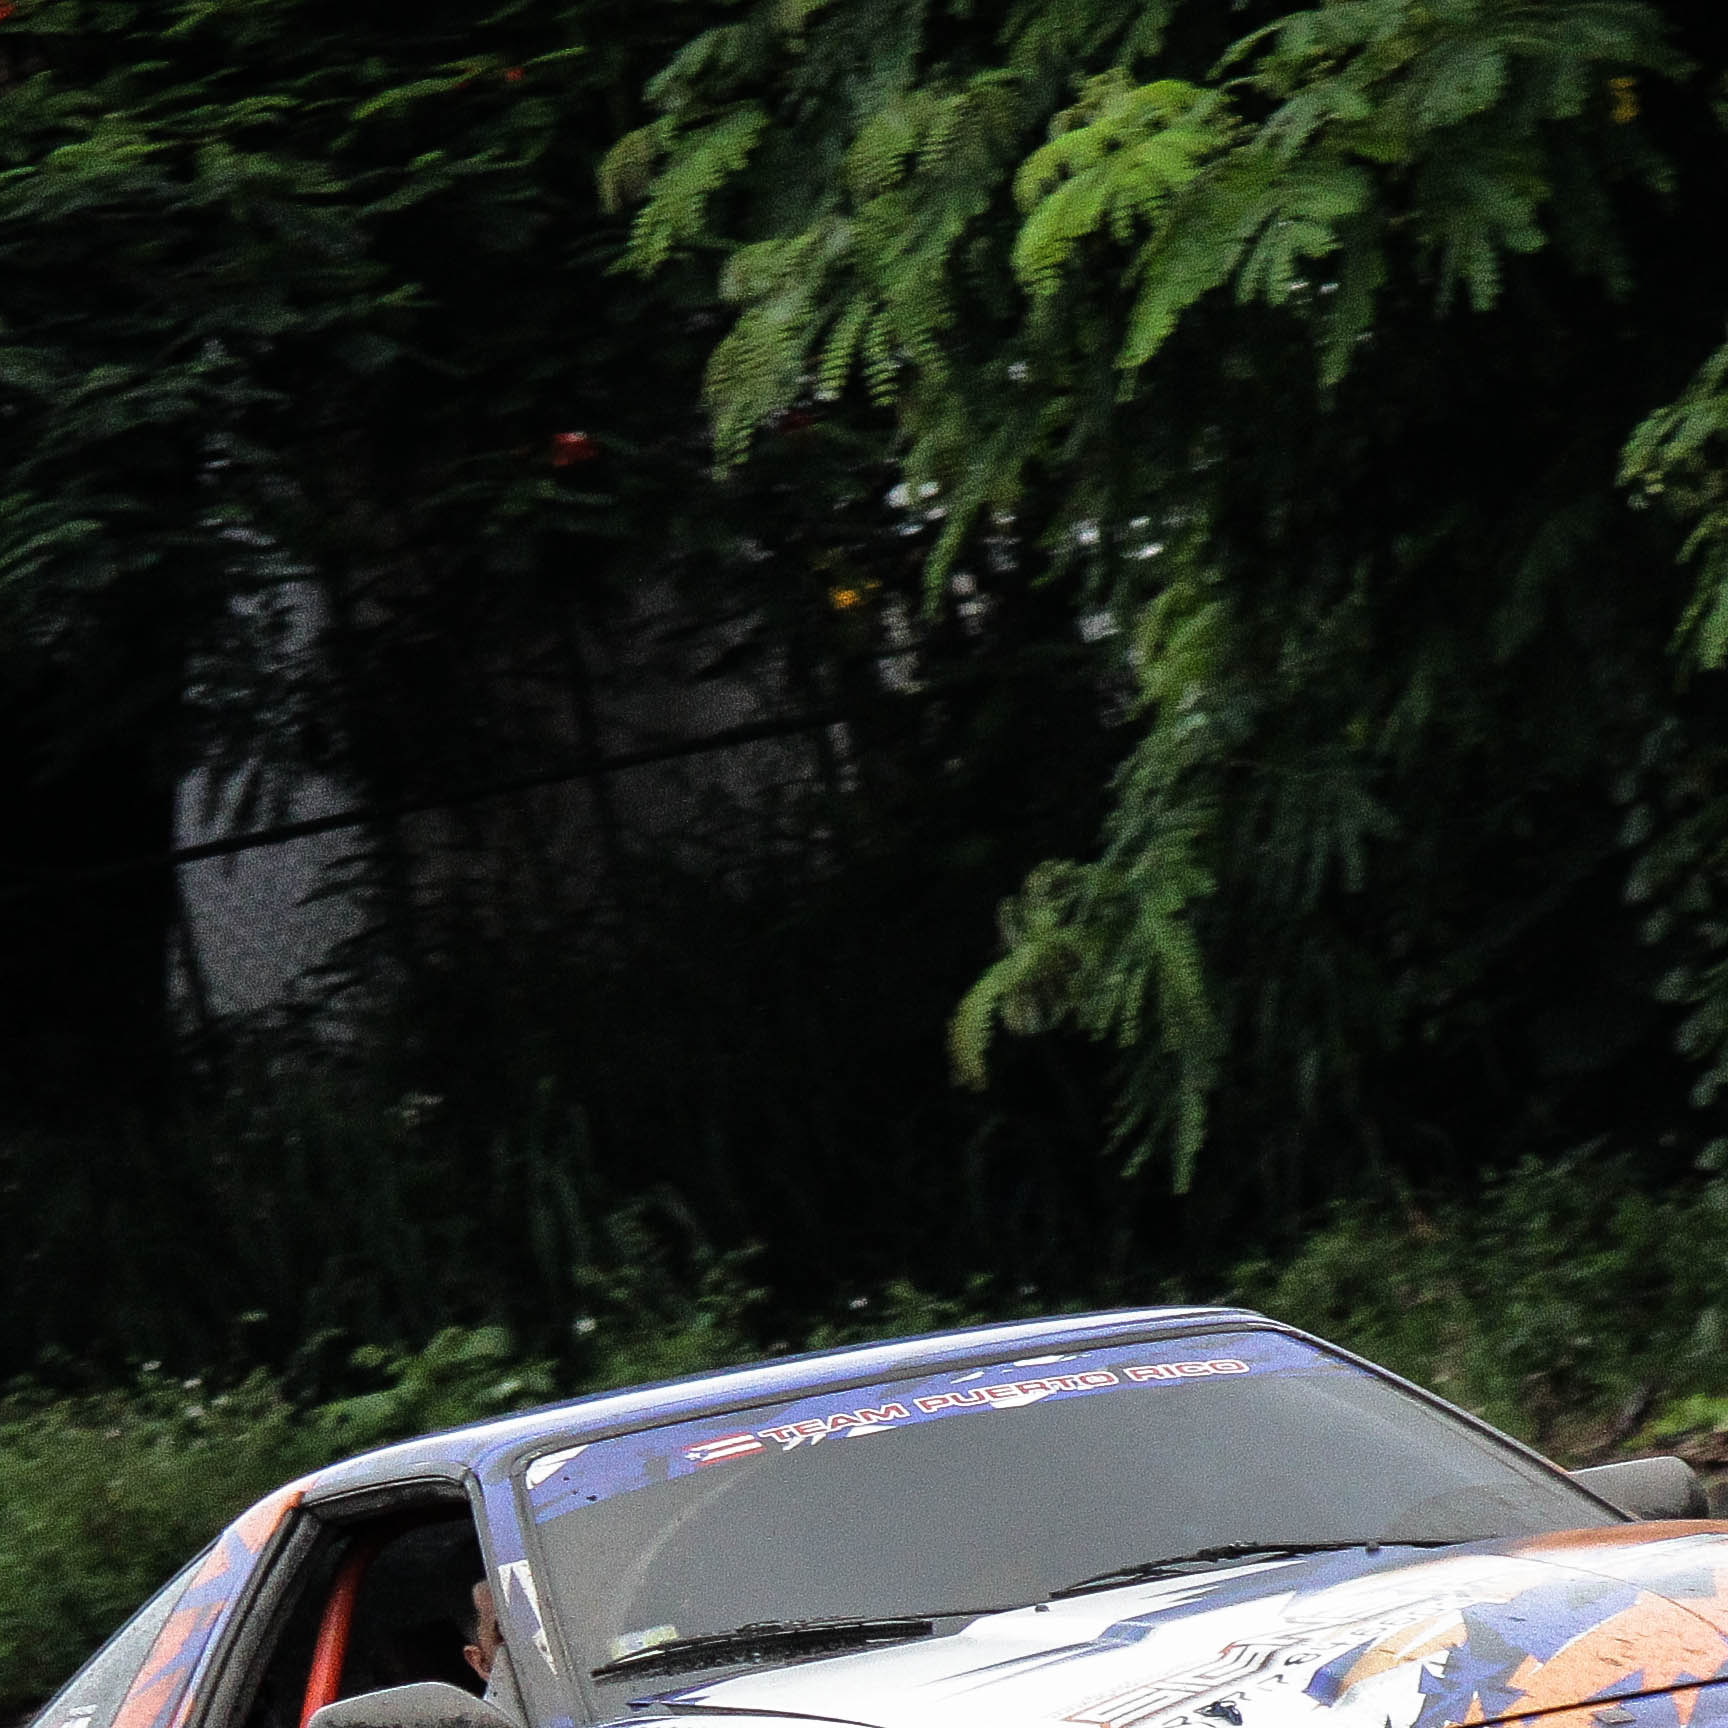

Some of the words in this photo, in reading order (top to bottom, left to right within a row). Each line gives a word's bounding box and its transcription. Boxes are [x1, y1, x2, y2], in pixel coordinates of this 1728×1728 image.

[760, 1401, 909, 1444] TEAM
[913, 1369, 1118, 1415] PUERTO
[1124, 1358, 1251, 1385] RICO
